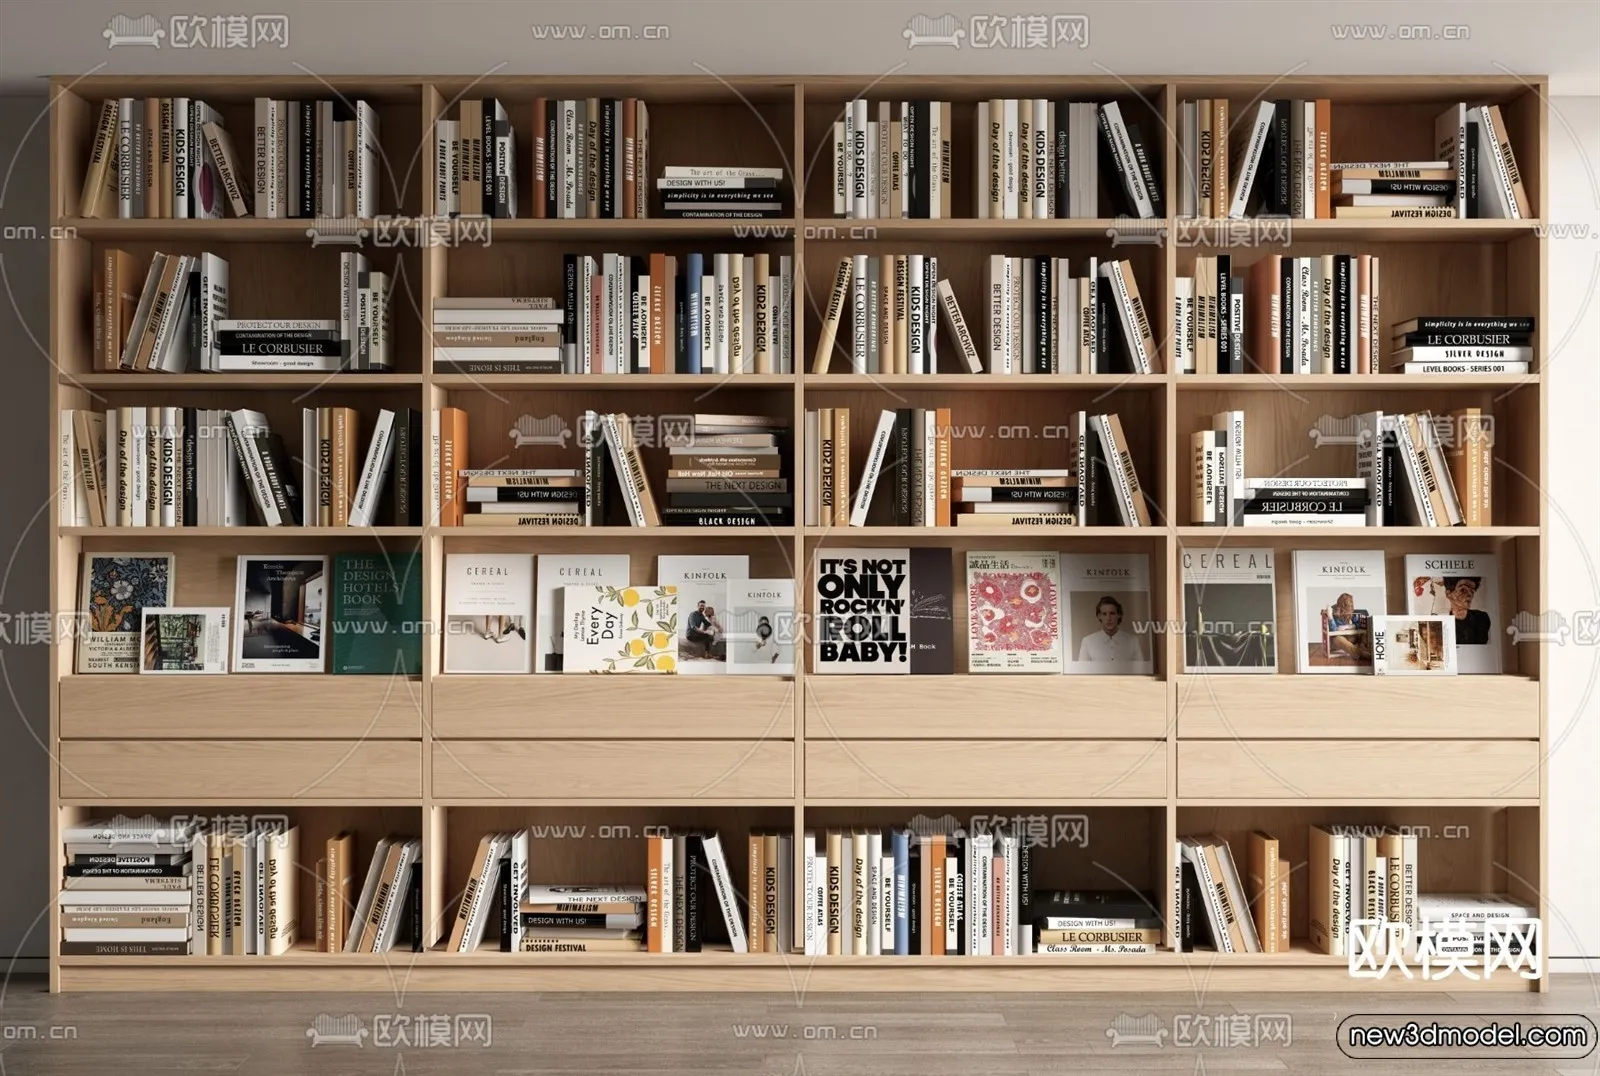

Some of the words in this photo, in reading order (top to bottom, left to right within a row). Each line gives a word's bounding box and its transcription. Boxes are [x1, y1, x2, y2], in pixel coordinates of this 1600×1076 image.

[121, 120, 130, 133] LE
[588, 121, 597, 139] Day
[991, 122, 1001, 140] Day
[176, 129, 186, 154] KIDS
[256, 126, 265, 158] BETTER
[451, 141, 459, 151] BE
[589, 141, 597, 151] of
[855, 131, 865, 156] KIDS
[992, 142, 1001, 153] of
[121, 136, 130, 200] CORBUSIER
[589, 153, 597, 168] the
[992, 154, 1001, 170] the
[176, 156, 185, 196] DESIGN
[209, 137, 227, 167] BETTER
[220, 166, 240, 201] ARCHVIZ
[451, 154, 459, 195] YOURSELF
[257, 160, 265, 194] DESIGN
[667, 179, 692, 187] DESIGN
[714, 179, 725, 187] US!
[855, 158, 865, 198] DESIGN
[588, 171, 597, 201] design
[991, 172, 1001, 202] design
[667, 192, 699, 200] simplicity
[717, 192, 751, 200] everything
[897, 260, 905, 287] DESIGN
[372, 292, 379, 302] BE
[897, 289, 905, 320] FESTIVAL
[911, 286, 921, 311] KIDS
[911, 314, 921, 354] DESIGN
[1428, 335, 1441, 345] LE
[1444, 334, 1510, 345] CORBUSIER
[243, 343, 255, 353] LE
[258, 343, 323, 354] CORBUSIER
[1445, 350, 1471, 358] SILVER
[1476, 350, 1504, 358] DESIGN
[1443, 365, 1466, 373] BOOKS
[1470, 365, 1492, 373] SERIES
[163, 438, 173, 463] KIDS
[163, 466, 173, 506] DESIGN
[707, 481, 721, 490] THE
[724, 480, 746, 490] NEXT
[749, 480, 782, 491] DESIGN
[699, 517, 723, 526] BLACK
[727, 517, 755, 526] DESIGN
[343, 559, 374, 570] THE
[820, 559, 857, 574] IT'S
[862, 559, 906, 574] NOT
[1183, 553, 1272, 569] CEREAL
[1425, 559, 1475, 569] SCHIELE
[343, 571, 396, 581] DESIGN
[467, 567, 508, 576] CEREAL
[559, 567, 603, 577] CEREAL
[1086, 568, 1131, 576] KINFOLK
[1322, 566, 1366, 574] KINFOLK
[817, 574, 906, 599] ONLY
[343, 595, 383, 605] BOOK
[820, 599, 905, 614] ROCK'N'
[586, 606, 603, 645] Every
[601, 612, 618, 640] Day
[820, 615, 906, 641] ROLL
[820, 642, 907, 663] BABY!
[1375, 631, 1385, 660] HOME
[829, 866, 839, 891] KIDS
[884, 878, 891, 888] BE
[610, 894, 643, 903] DESIGN
[557, 903, 598, 912] MINIMALISM
[829, 893, 839, 934] DESIGN
[575, 917, 587, 925] US!
[1062, 932, 1075, 942] LE
[1078, 932, 1143, 942] CORBUSIER
[526, 944, 552, 952] DESIGN
[555, 944, 585, 952] FESTIVAL
[1046, 944, 1067, 953] Class
[1070, 944, 1092, 953] Room
[1101, 944, 1116, 953] Ms.
[1118, 945, 1146, 953] Posada
